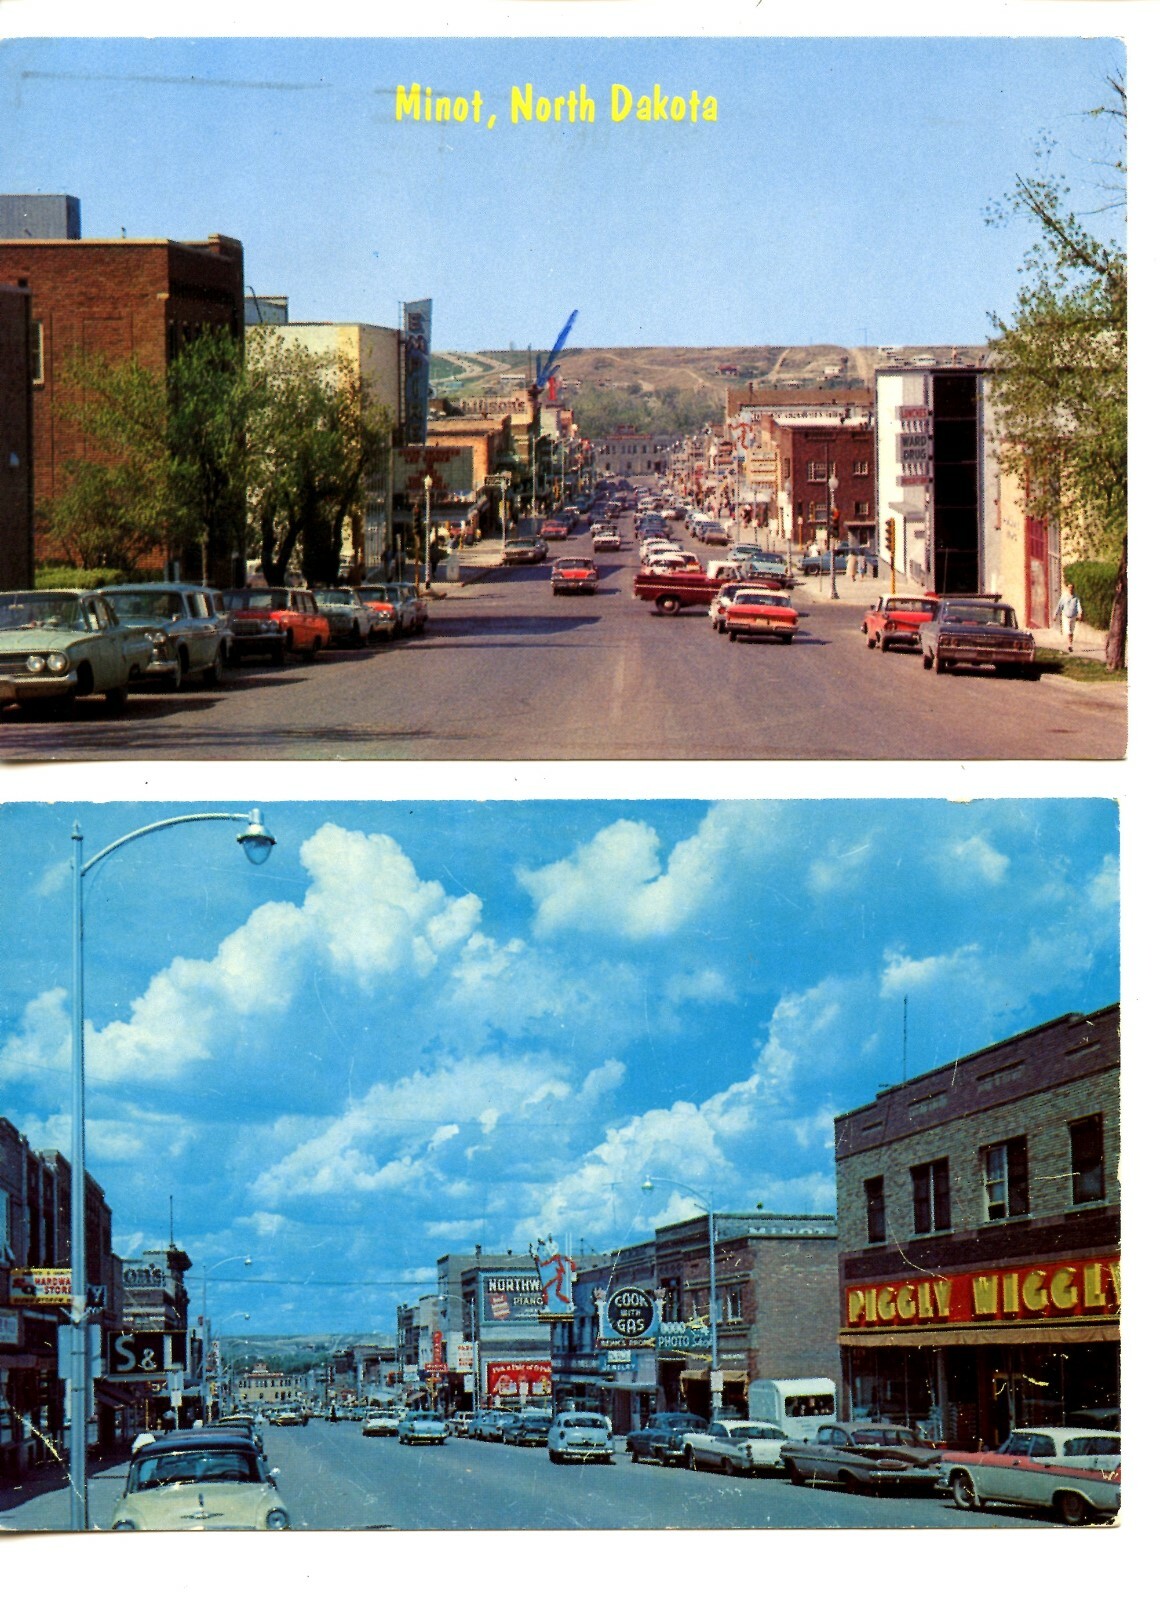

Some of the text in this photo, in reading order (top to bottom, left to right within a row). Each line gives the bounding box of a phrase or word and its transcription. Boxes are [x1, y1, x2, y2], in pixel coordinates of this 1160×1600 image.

[902, 435, 927, 447] WARD
[903, 449, 927, 461] DRUG
[34, 1276, 72, 1286] HARDWA
[614, 1291, 648, 1308] COOK
[848, 1280, 950, 1323] PIGGLY
[620, 1308, 642, 1318] WITH
[616, 1318, 646, 1334] GAS
[658, 1335, 690, 1348] PHOTO
[114, 1334, 184, 1371] S & L
